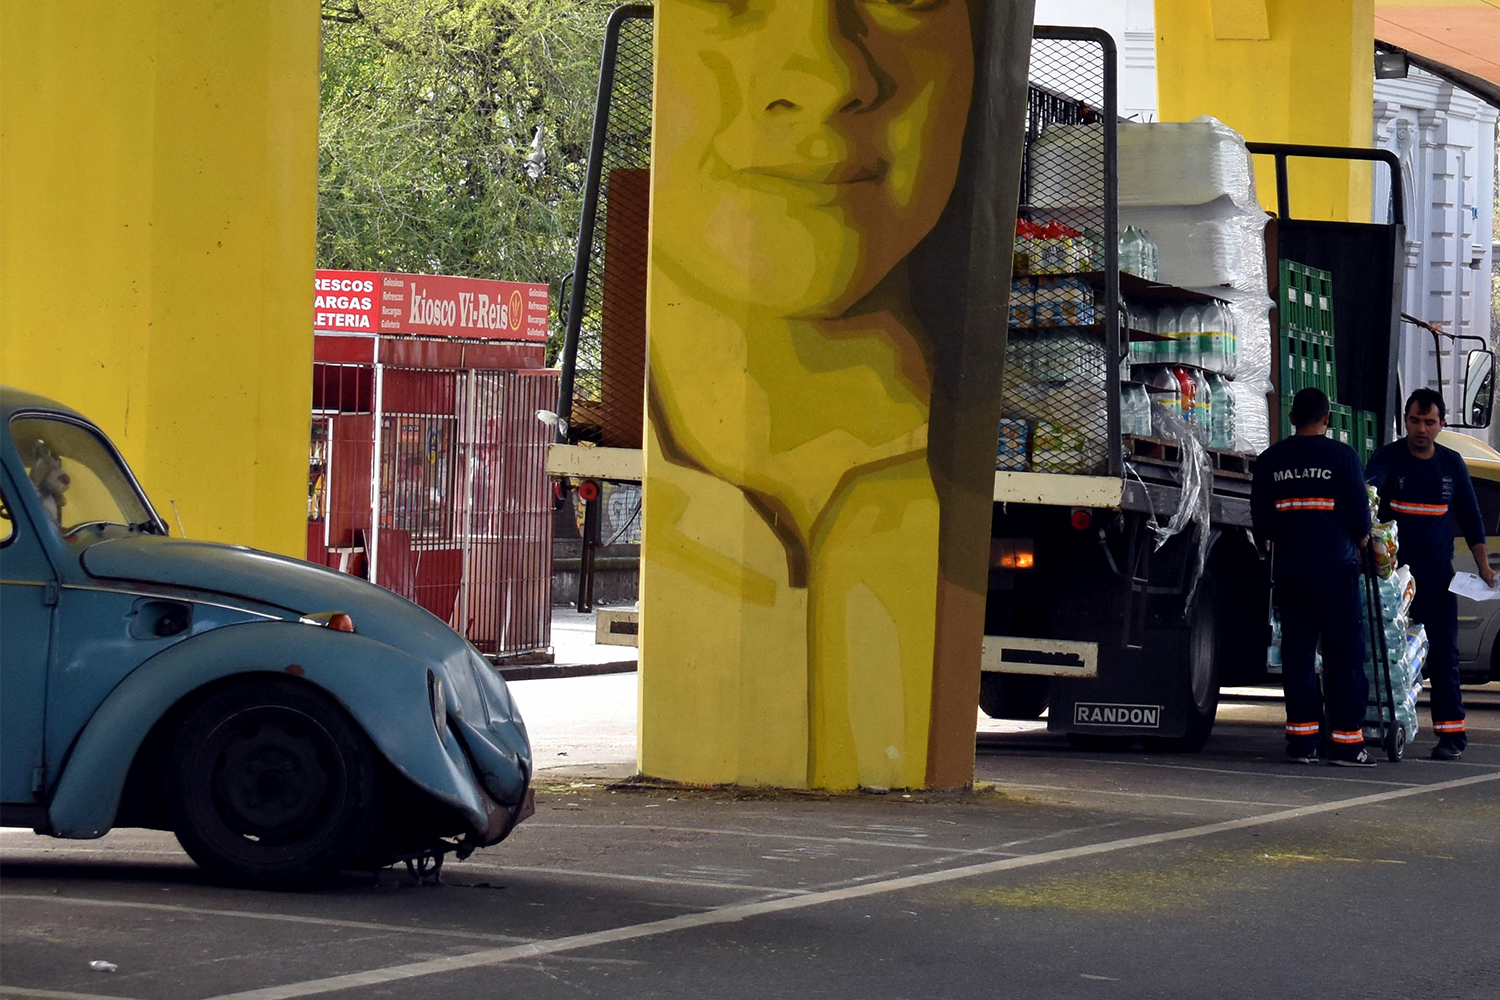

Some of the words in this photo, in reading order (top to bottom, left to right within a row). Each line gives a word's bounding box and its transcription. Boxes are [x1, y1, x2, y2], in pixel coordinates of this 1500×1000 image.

[314, 295, 372, 310] ARGAS
[458, 291, 508, 330] Vi-Reis
[314, 312, 370, 328] ETERIA
[1273, 467, 1332, 482] MALATIC
[1077, 706, 1156, 724] RANDON
